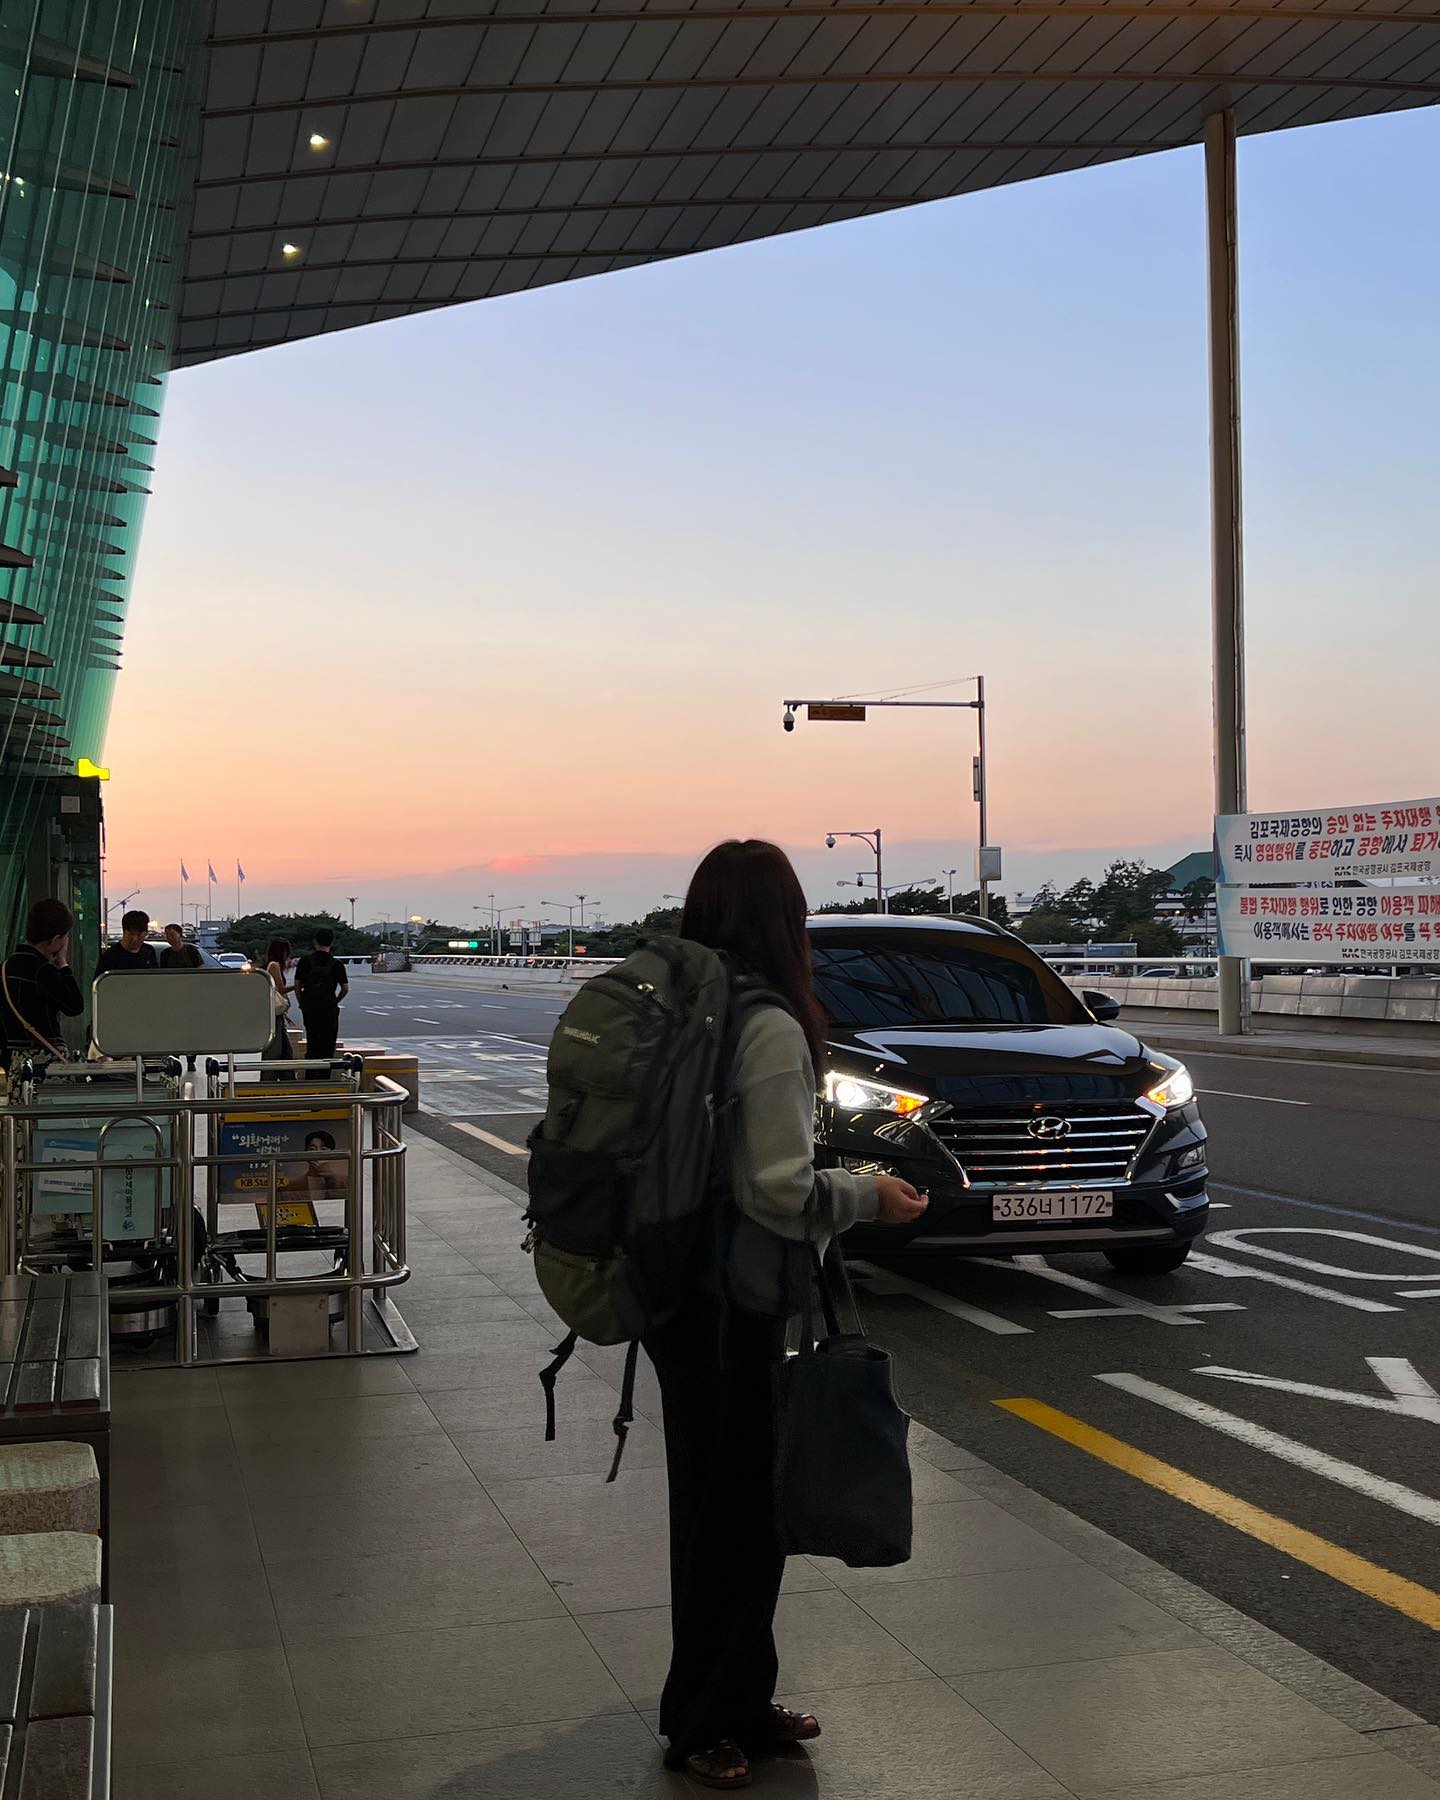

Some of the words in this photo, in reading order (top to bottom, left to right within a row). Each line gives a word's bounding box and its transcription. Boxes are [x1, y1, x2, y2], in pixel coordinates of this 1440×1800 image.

[1250, 817, 1322, 839] 김포국제공항의
[1327, 815, 1349, 835] 승인
[1353, 813, 1377, 832] 없는
[1381, 807, 1432, 830] 주차대행
[1234, 844, 1252, 862] 즉시
[1256, 841, 1306, 862] 영업행위를
[1309, 839, 1355, 859] 중단하고
[1357, 834, 1408, 857] 공항에서
[1410, 832, 1440, 852] 퇴거
[1240, 897, 1257, 915] 불법
[1261, 897, 1297, 916] 주차대행
[1300, 896, 1329, 916] 행위로
[1332, 896, 1353, 916] 인한
[1356, 896, 1377, 916] 공항
[1381, 895, 1414, 916] 이용객
[1312, 922, 1333, 941] 공식
[1335, 923, 1378, 942] 주차대행
[1381, 923, 1415, 942] 여부를
[240, 1178, 253, 1188] KB
[1000, 1197, 1052, 1218] 336너
[1058, 1195, 1106, 1215] 1172
